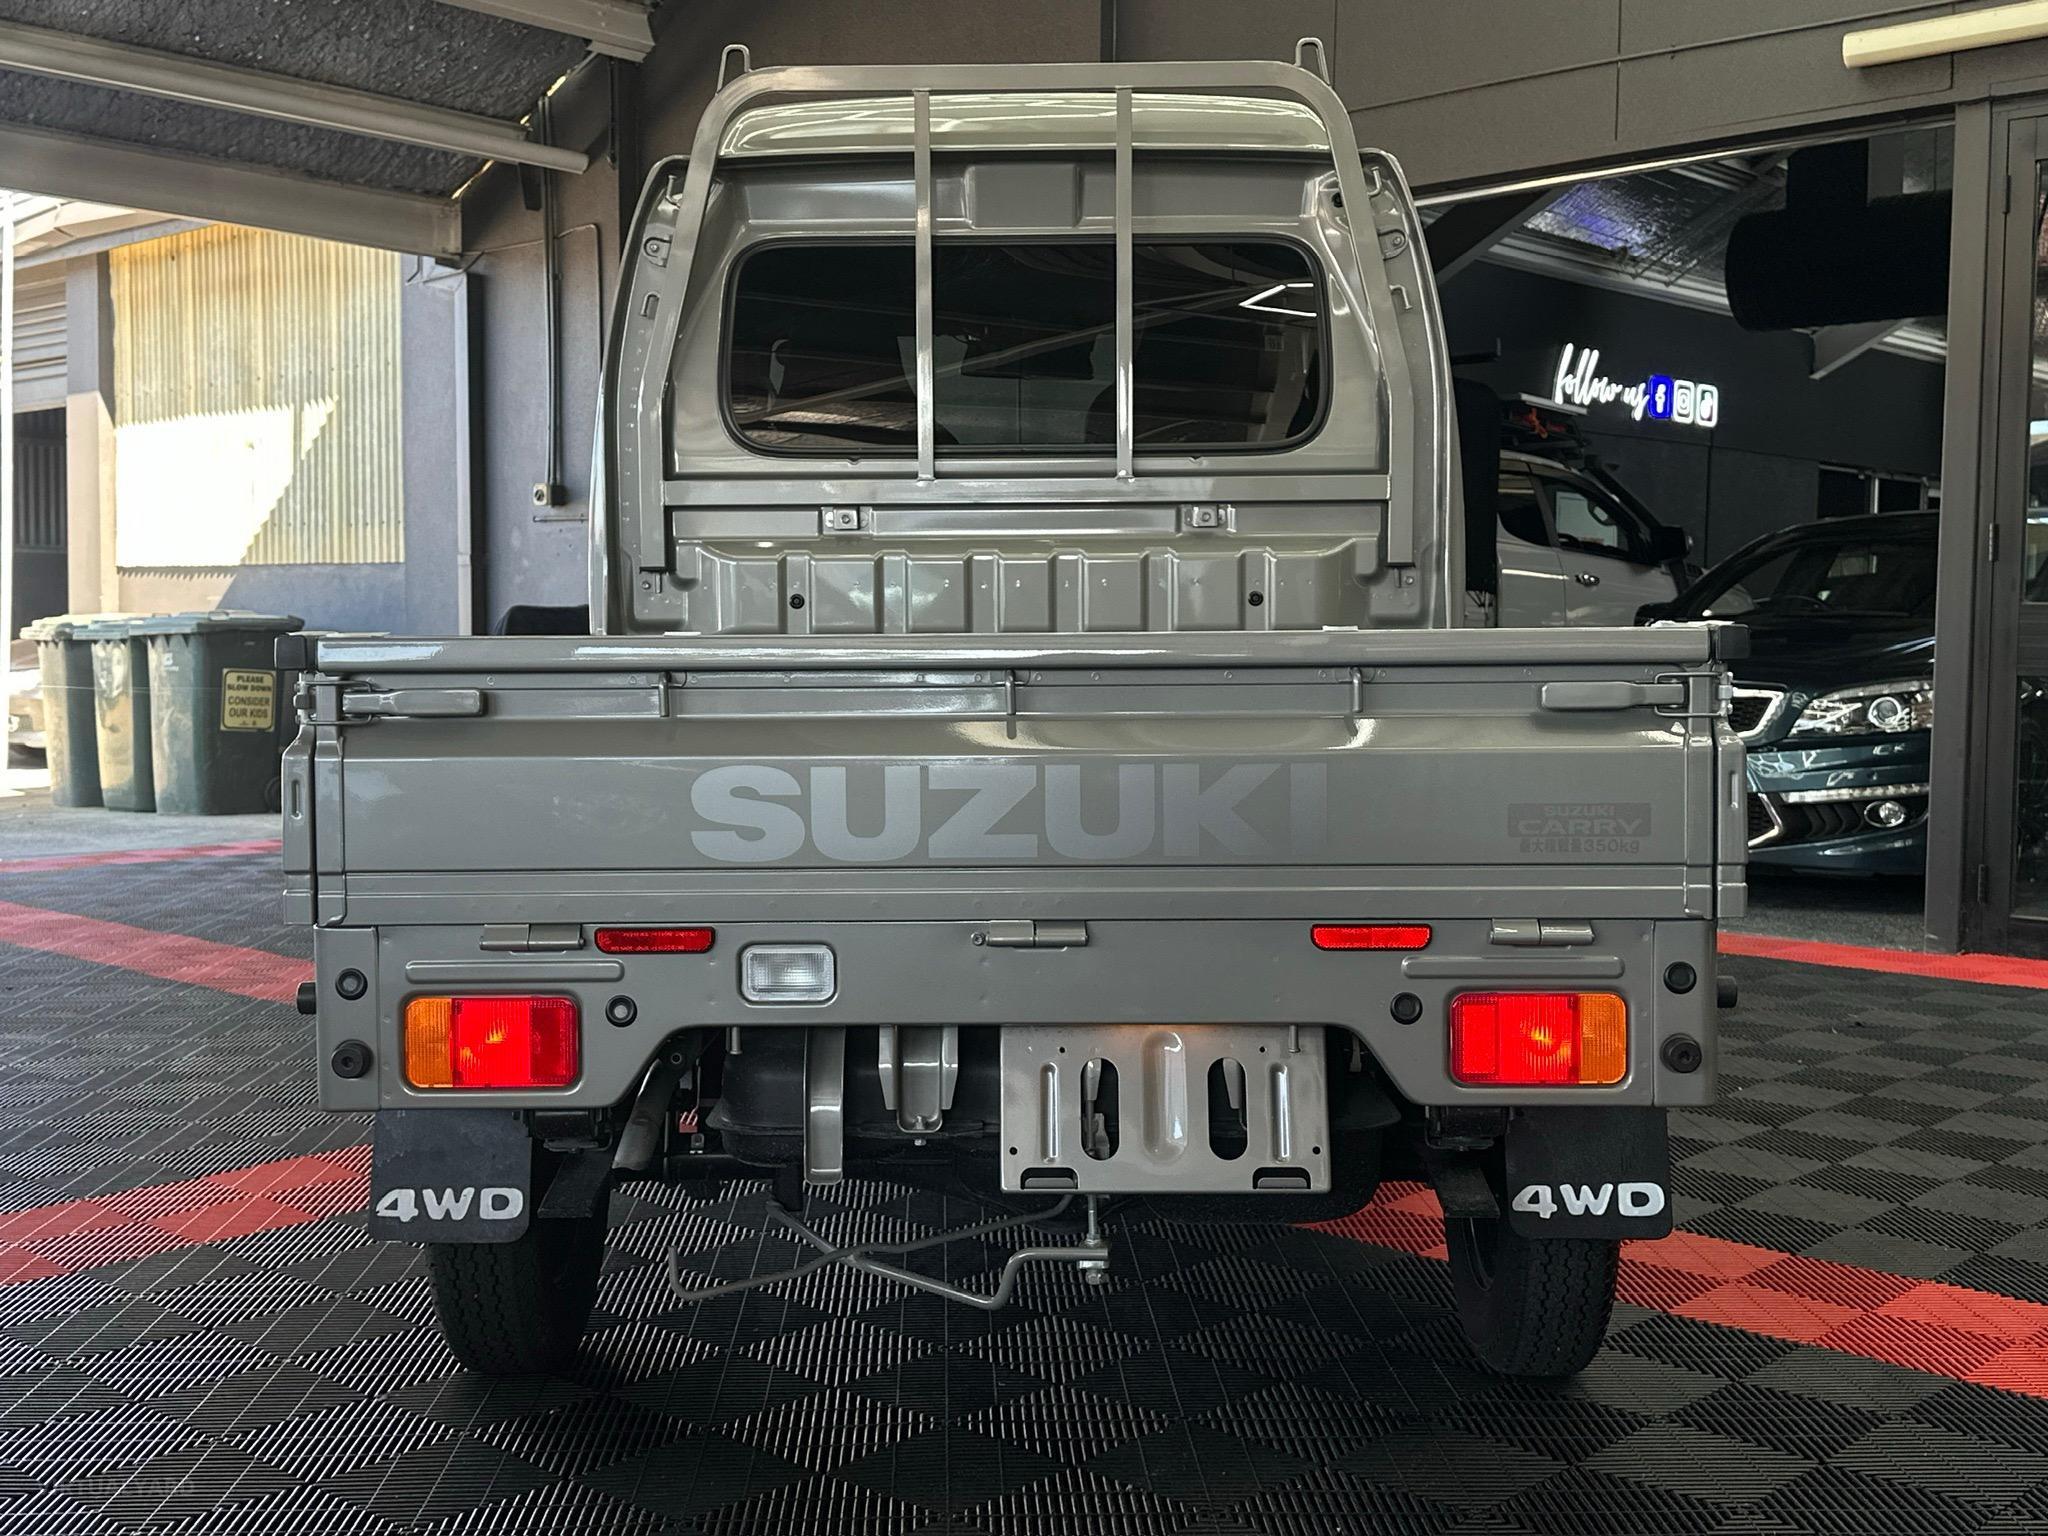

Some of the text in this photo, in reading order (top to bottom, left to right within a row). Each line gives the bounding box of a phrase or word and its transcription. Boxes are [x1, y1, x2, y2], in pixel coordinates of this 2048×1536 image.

[1554, 342, 1650, 421] follow us
[236, 675, 264, 684] PLEASE
[227, 684, 272, 692] SLOW DOWN
[228, 695, 270, 706] CONSIDER
[228, 707, 268, 719] OUR KIDS
[691, 763, 1327, 862] SUZUKI
[1543, 804, 1616, 816] SUZUKI
[1517, 818, 1642, 835] CARRY
[376, 1187, 523, 1222] 4WD
[1512, 1182, 1665, 1219] 4WD
